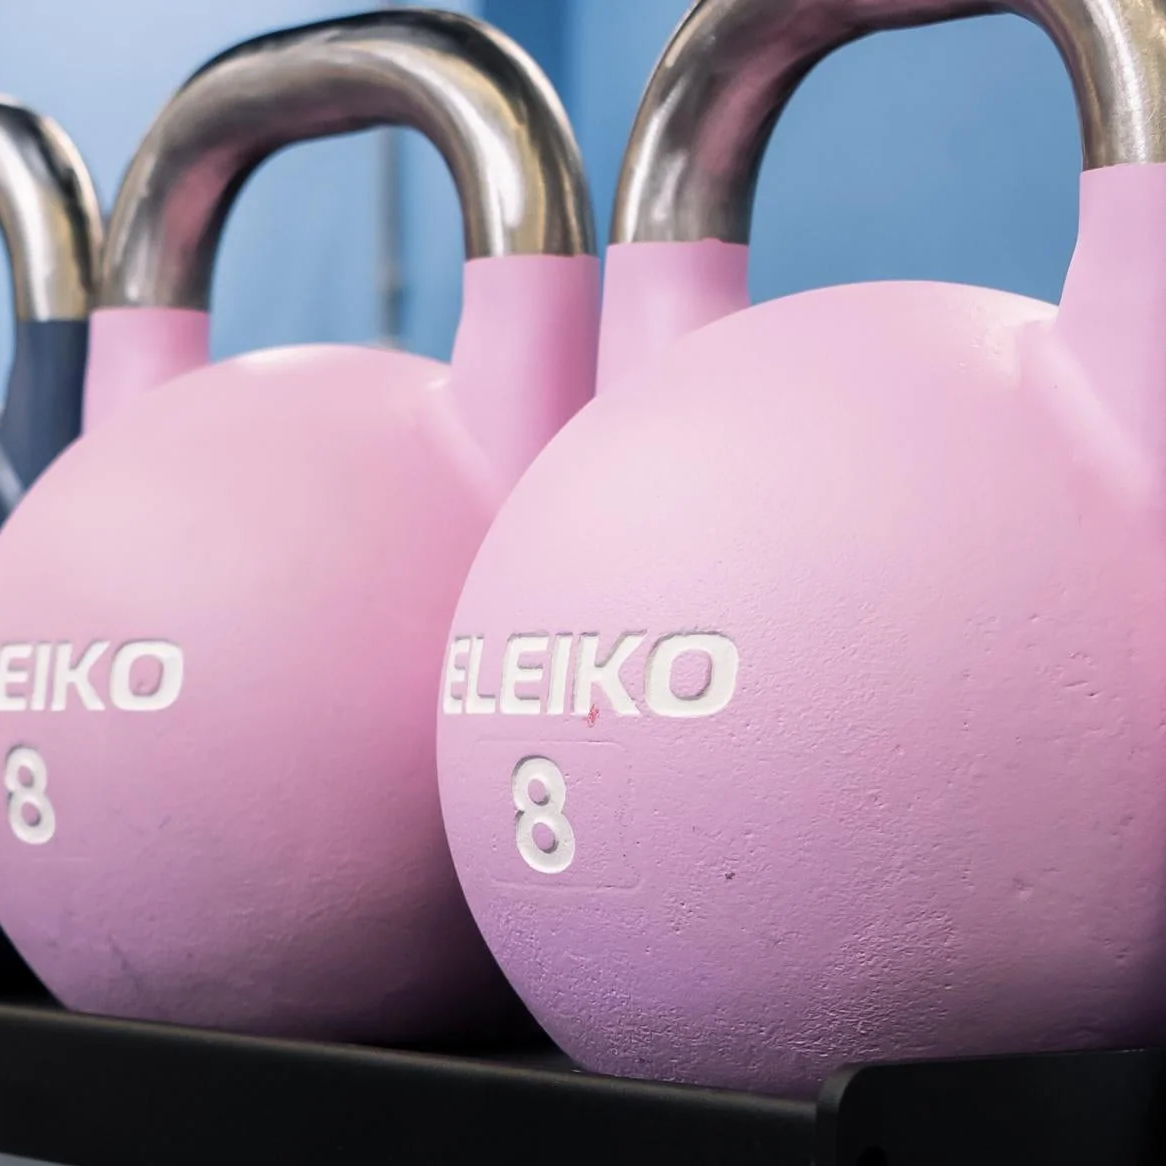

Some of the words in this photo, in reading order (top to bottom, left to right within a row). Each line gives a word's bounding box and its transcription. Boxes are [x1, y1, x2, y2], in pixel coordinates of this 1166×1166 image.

[442, 630, 739, 719] ELEIKO
[3, 743, 57, 846] 8
[510, 754, 576, 875] 8
